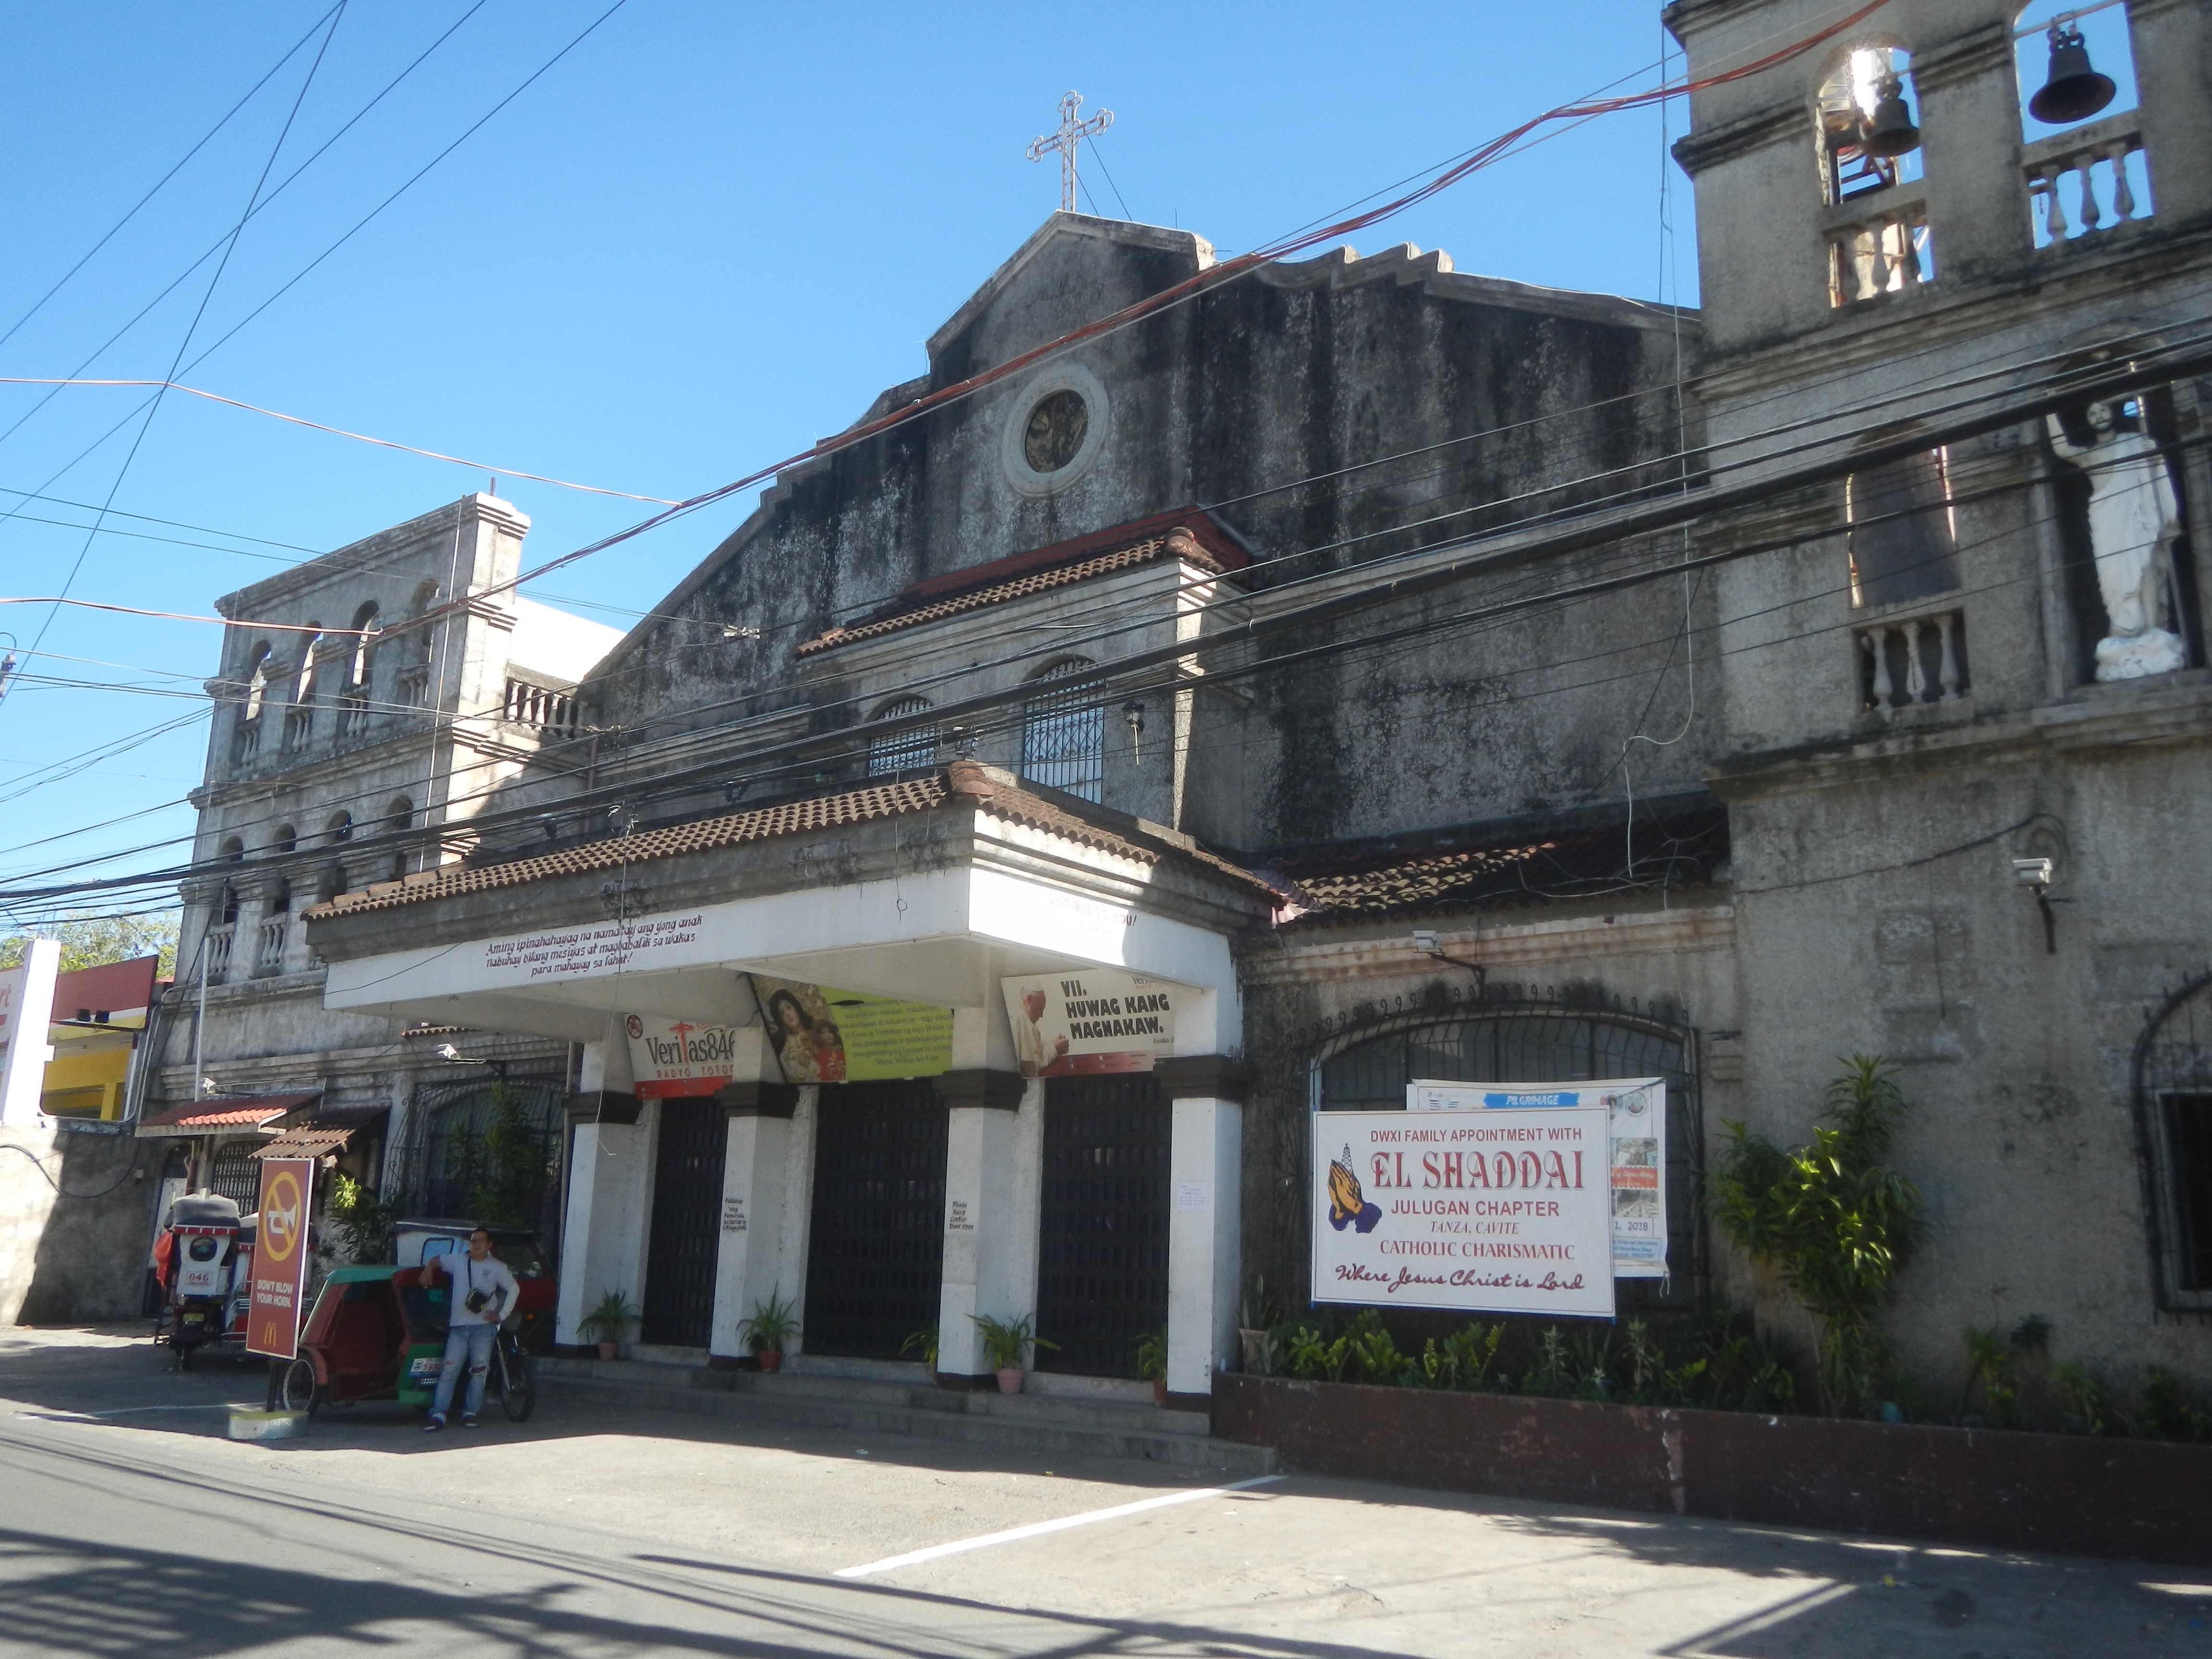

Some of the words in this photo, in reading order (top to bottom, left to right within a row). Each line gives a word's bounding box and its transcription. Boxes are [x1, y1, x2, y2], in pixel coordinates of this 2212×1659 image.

[485, 941, 515, 956] Aming
[517, 933, 579, 952] ipinahahayag
[580, 932, 591, 941] na
[637, 924, 654, 936] ang
[678, 914, 703, 928] anak
[486, 954, 522, 968] nabuhay
[523, 952, 549, 964] bilang
[550, 946, 586, 961] mesiyas
[587, 943, 598, 955] at
[599, 937, 650, 956] magbabalik
[653, 938, 663, 948] sa
[665, 933, 697, 946] wakas
[531, 964, 552, 977] para
[554, 960, 590, 974] mahayag
[593, 960, 602, 969] sa
[1060, 979, 1087, 998] VII.
[1065, 998, 1121, 1019] HUWAG
[1124, 993, 1170, 1014] KANG
[1070, 1016, 1164, 1040] MAGNAKAW.
[657, 1068, 690, 1078] RADYO
[1506, 1094, 1559, 1106] PILGRIMAGE
[1371, 1130, 1401, 1142] DWXI
[1405, 1130, 1446, 1142] FAMILY
[1450, 1128, 1543, 1142] APPOINTMENT
[1548, 1127, 1582, 1140] WITH
[1370, 1151, 1412, 1189] EL
[1422, 1150, 1585, 1190] SHADDAI
[1391, 1200, 1469, 1215] JULUGAN
[1475, 1201, 1560, 1217] CHAPTER
[1431, 1221, 1471, 1234] TANZA,
[1475, 1222, 1519, 1235] CAVITE
[1628, 1221, 1648, 1230] 2018
[1380, 1239, 1457, 1256] CATHOLIC
[1462, 1242, 1575, 1261] CHARISMATIC
[190, 1273, 209, 1281] 046
[1335, 1263, 1391, 1282] Where
[1388, 1266, 1447, 1293] Jesus
[1449, 1269, 1513, 1288] Christ
[1515, 1274, 1533, 1288] is
[1536, 1271, 1585, 1291] Lord
[257, 1279, 275, 1291] DON'T
[276, 1282, 294, 1294] BLOW
[256, 1292, 273, 1304] YOUR
